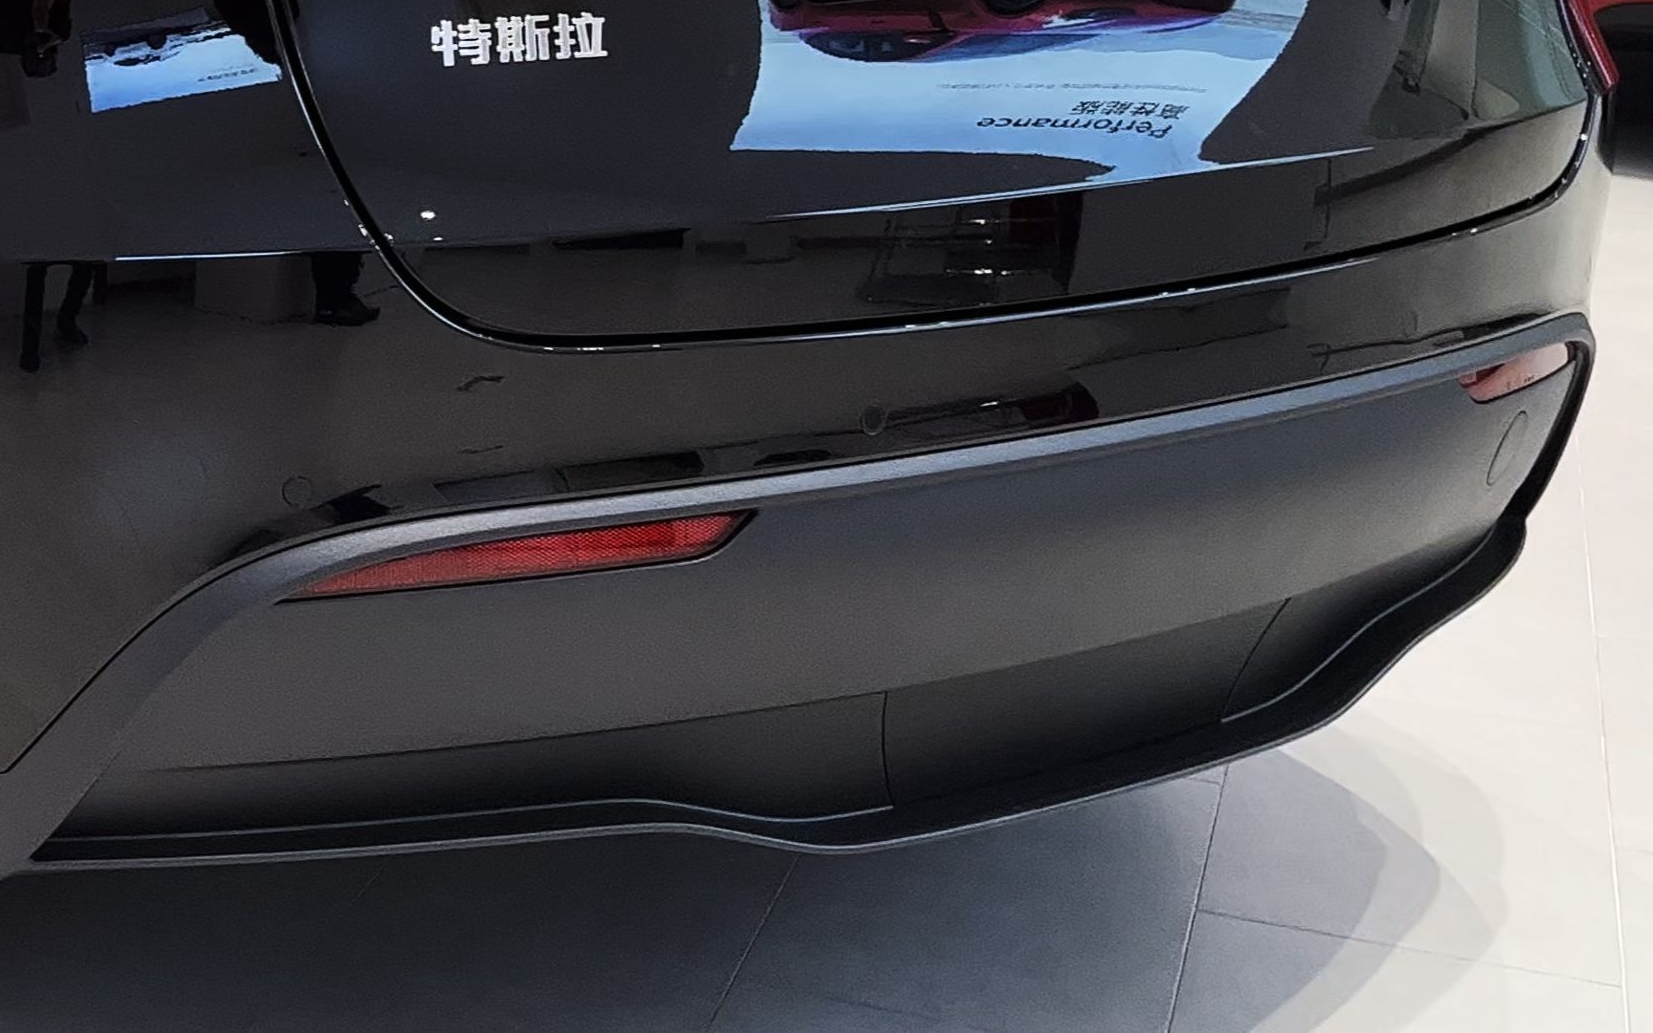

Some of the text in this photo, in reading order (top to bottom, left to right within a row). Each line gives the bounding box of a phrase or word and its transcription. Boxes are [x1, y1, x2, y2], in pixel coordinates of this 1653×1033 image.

[431, 12, 608, 67] 特斯拉
[977, 116, 1173, 139] Performance
